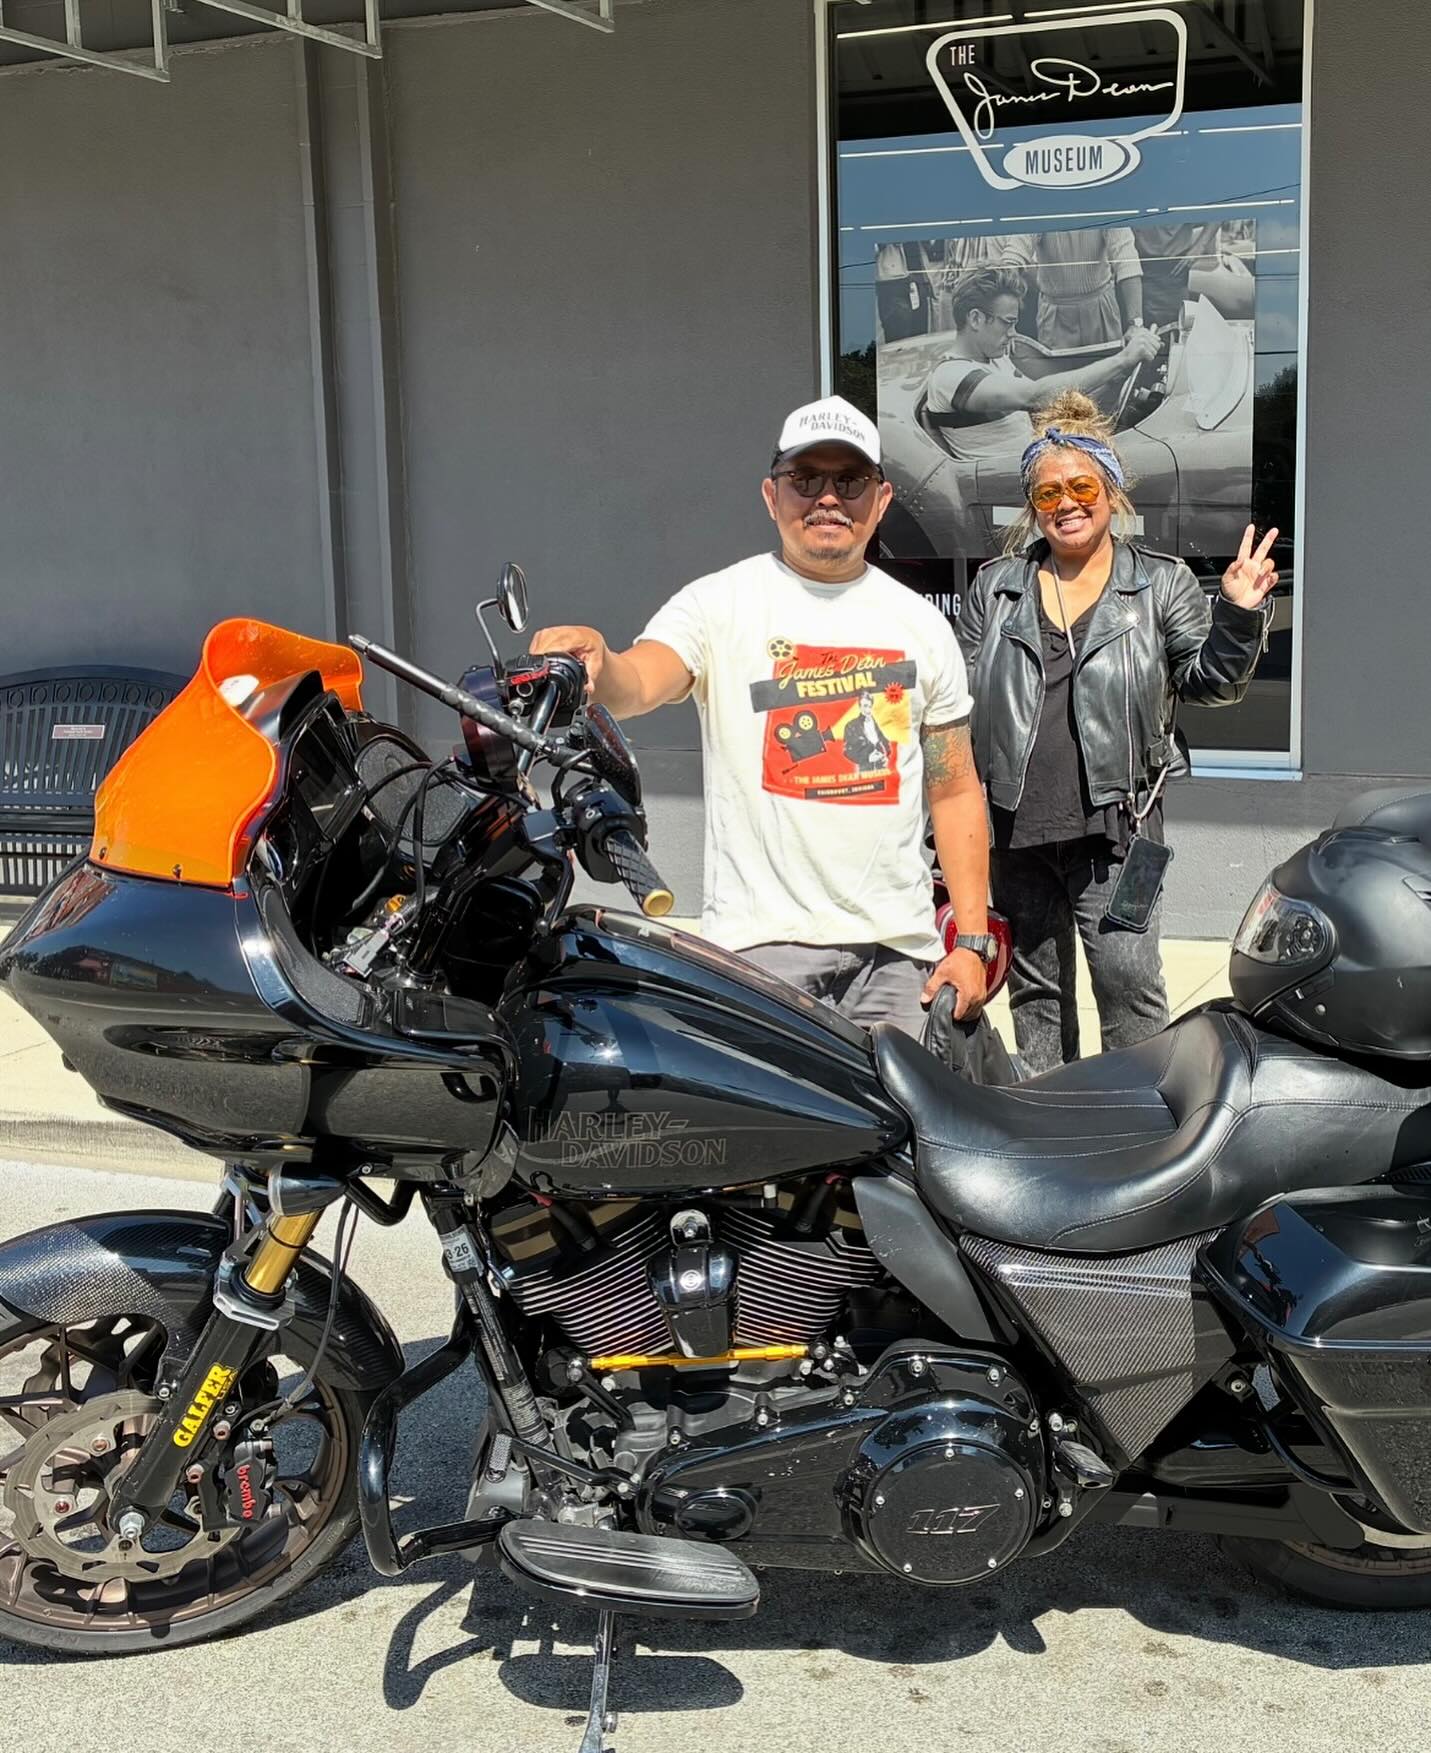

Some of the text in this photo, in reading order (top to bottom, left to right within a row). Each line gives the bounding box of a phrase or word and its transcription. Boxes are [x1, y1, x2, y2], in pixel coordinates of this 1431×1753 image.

[949, 44, 976, 66] THE
[1030, 58, 1174, 102] Dean
[1025, 145, 1103, 175] MUSEUM
[800, 411, 857, 428] HARLEY-
[810, 420, 866, 441] DAVIDSON
[779, 654, 887, 690] James Dean
[796, 671, 877, 698] FESTIVAL
[525, 1106, 690, 1145] HARLEY-
[561, 1138, 728, 1169] DAVIDSON
[173, 1363, 232, 1448] GALFER
[236, 1464, 257, 1520] brembo
[906, 1503, 1001, 1535] 117
